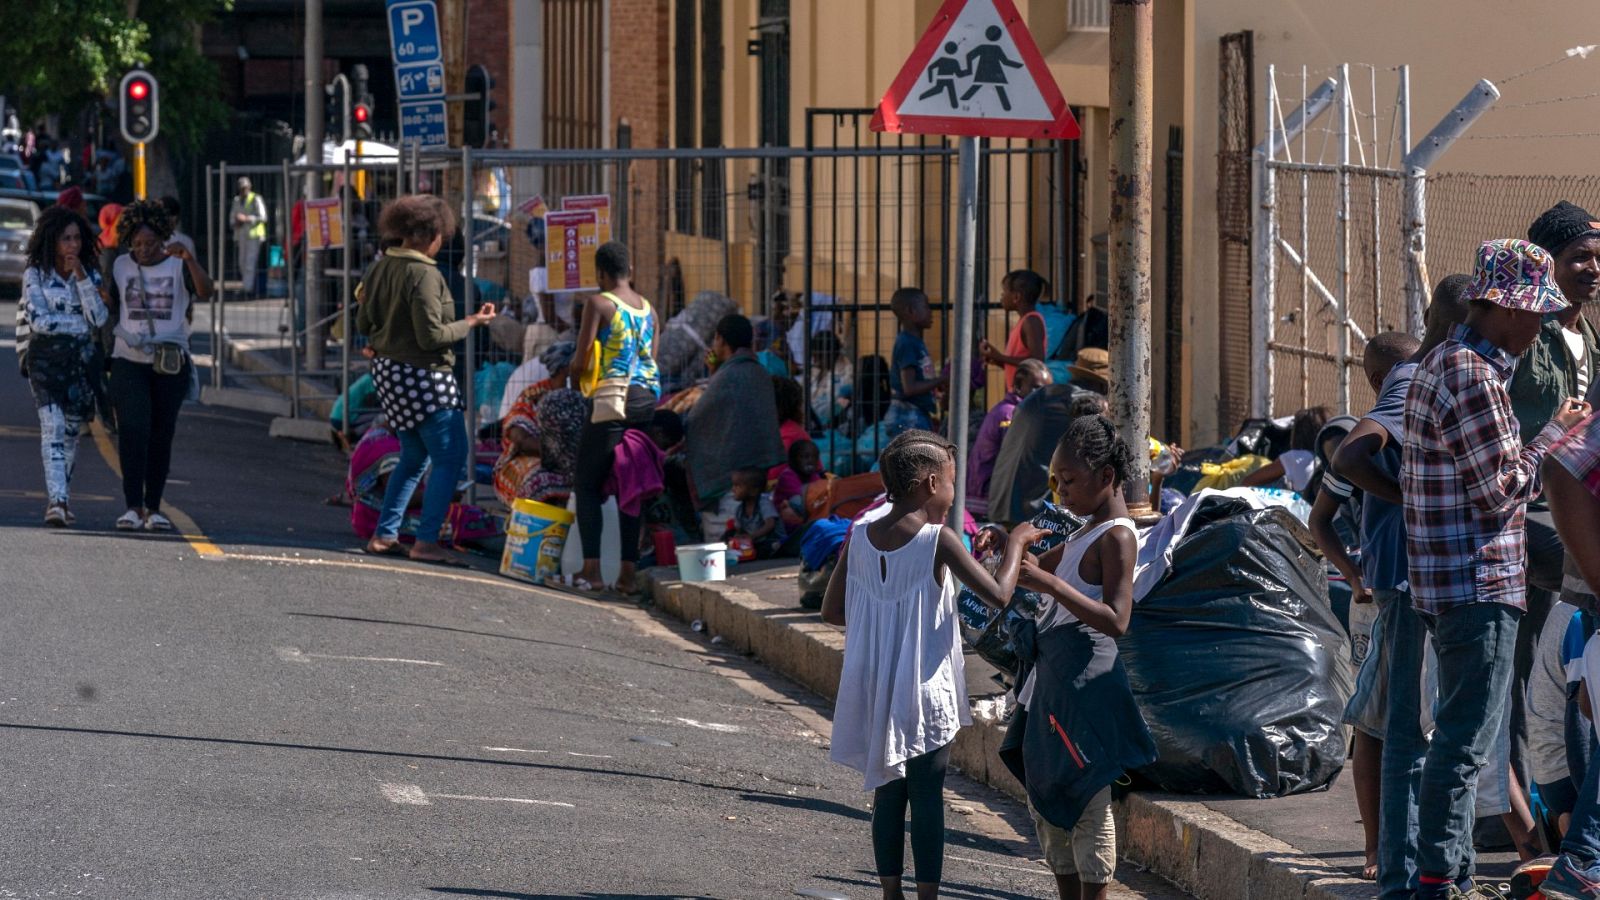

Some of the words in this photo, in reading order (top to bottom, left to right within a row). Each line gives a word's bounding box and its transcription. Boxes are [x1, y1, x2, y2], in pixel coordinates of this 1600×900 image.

[401, 8, 424, 36] P
[398, 42, 415, 56] 60
[1037, 519, 1066, 536] AFRICA
